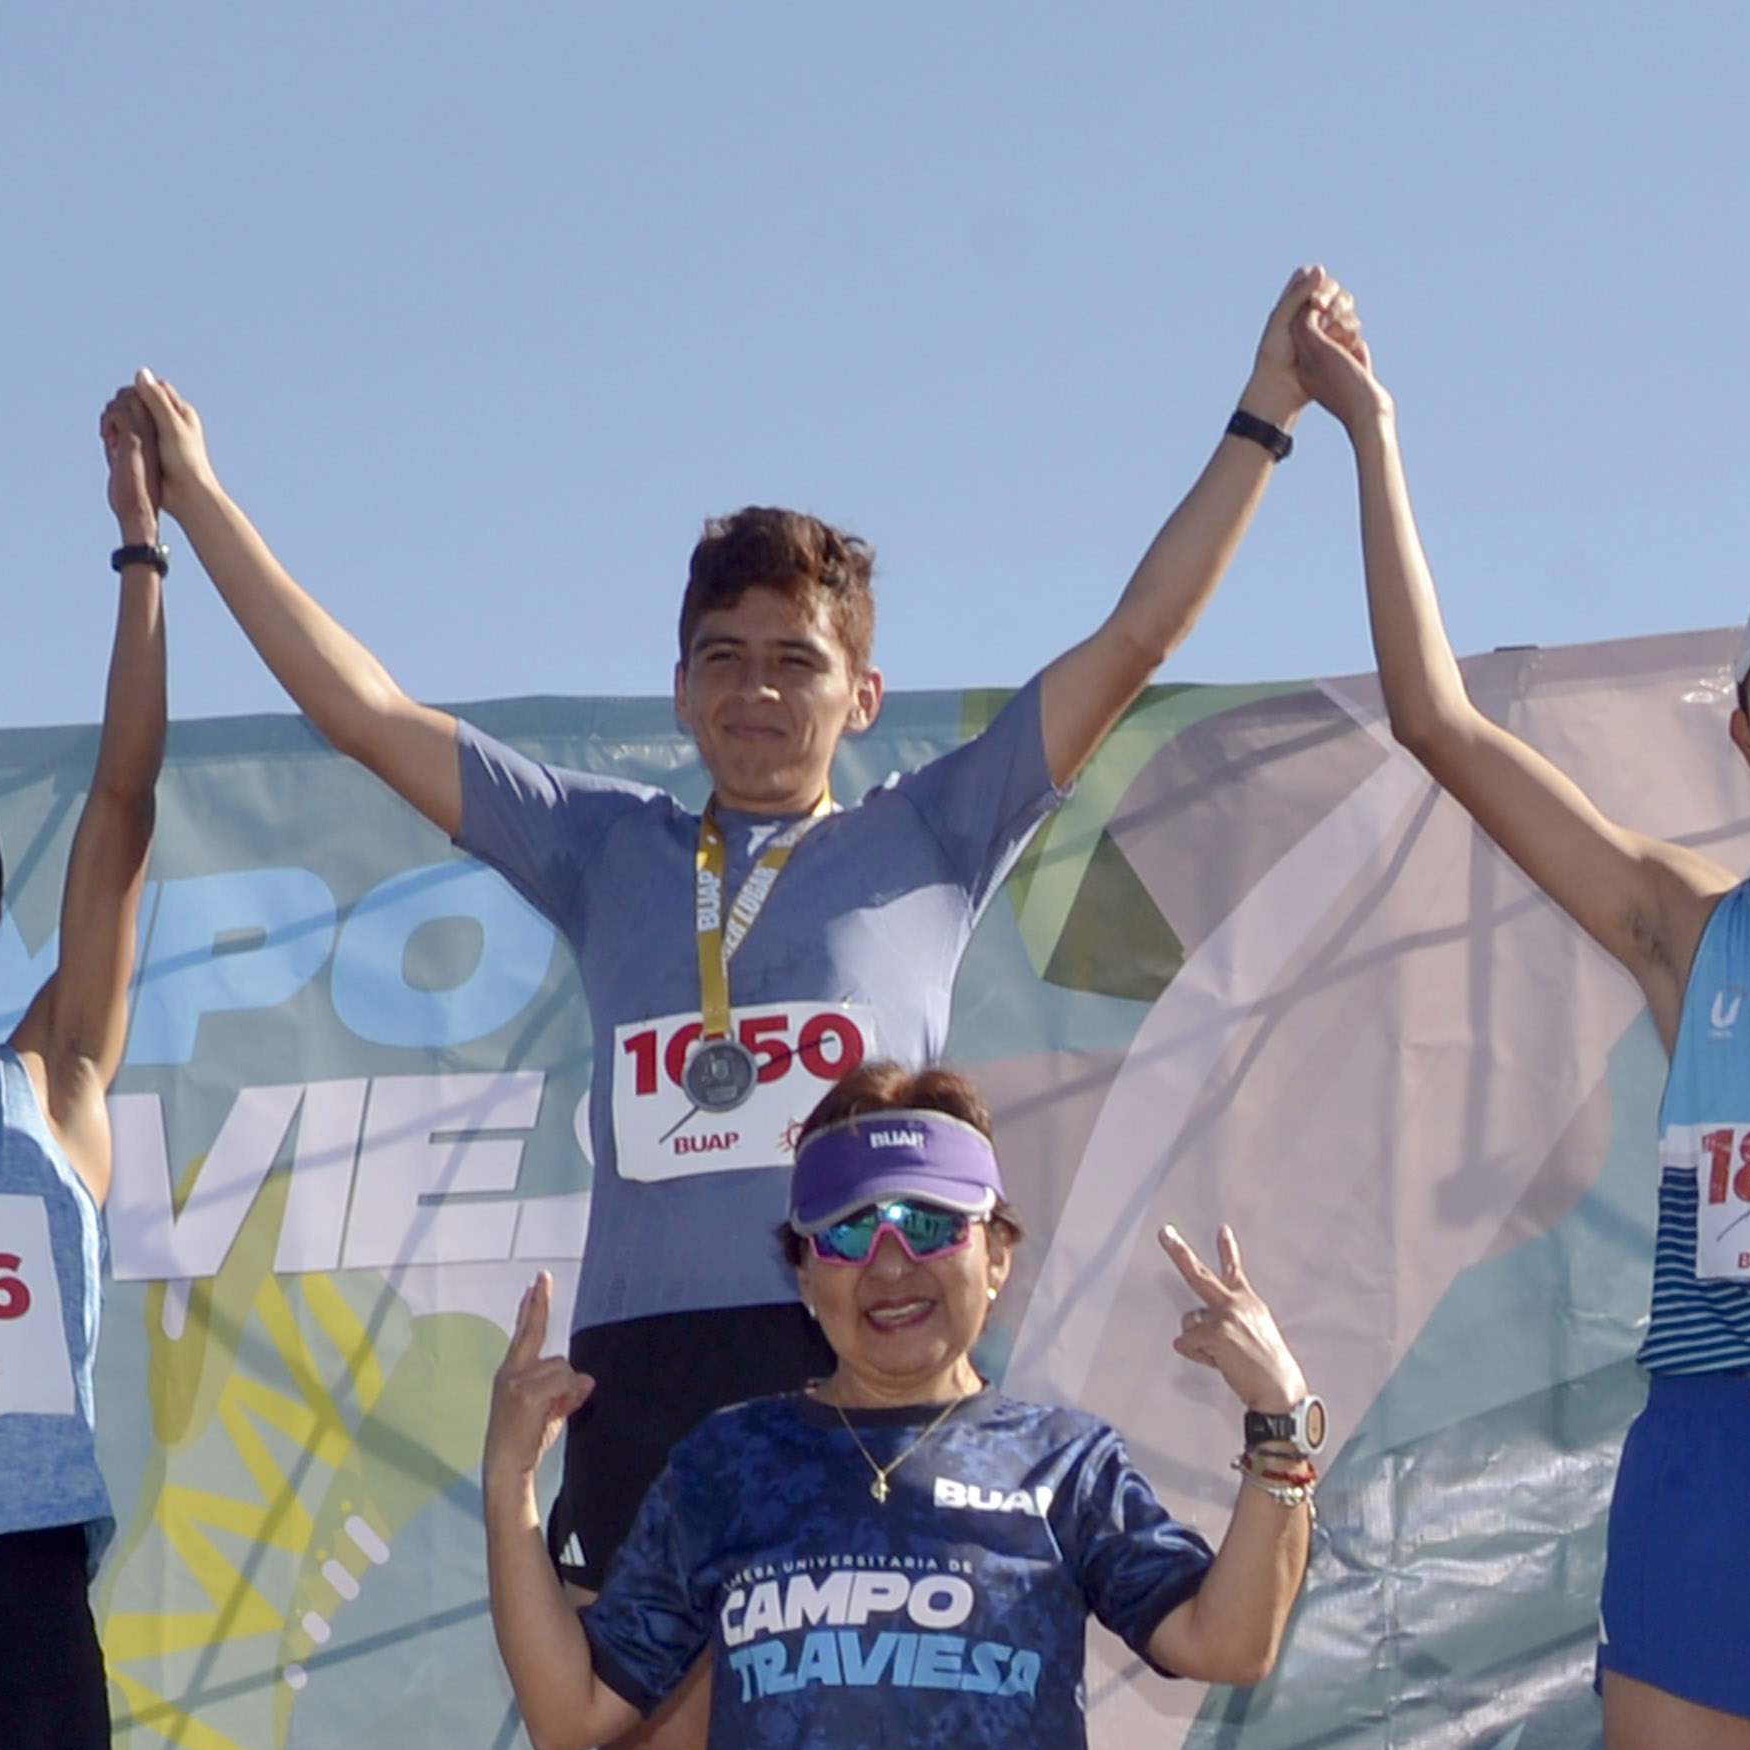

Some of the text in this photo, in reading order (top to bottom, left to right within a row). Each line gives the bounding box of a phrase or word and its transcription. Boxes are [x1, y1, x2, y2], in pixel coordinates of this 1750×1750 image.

[696, 868, 722, 932] BUAP
[674, 1132, 739, 1155] BUAP
[782, 1555, 938, 1575] UNIVERSITARIA
[948, 1558, 973, 1575] DE
[720, 1570, 975, 1647] CAMPO
[728, 1630, 1042, 1703] TRAVIESA
